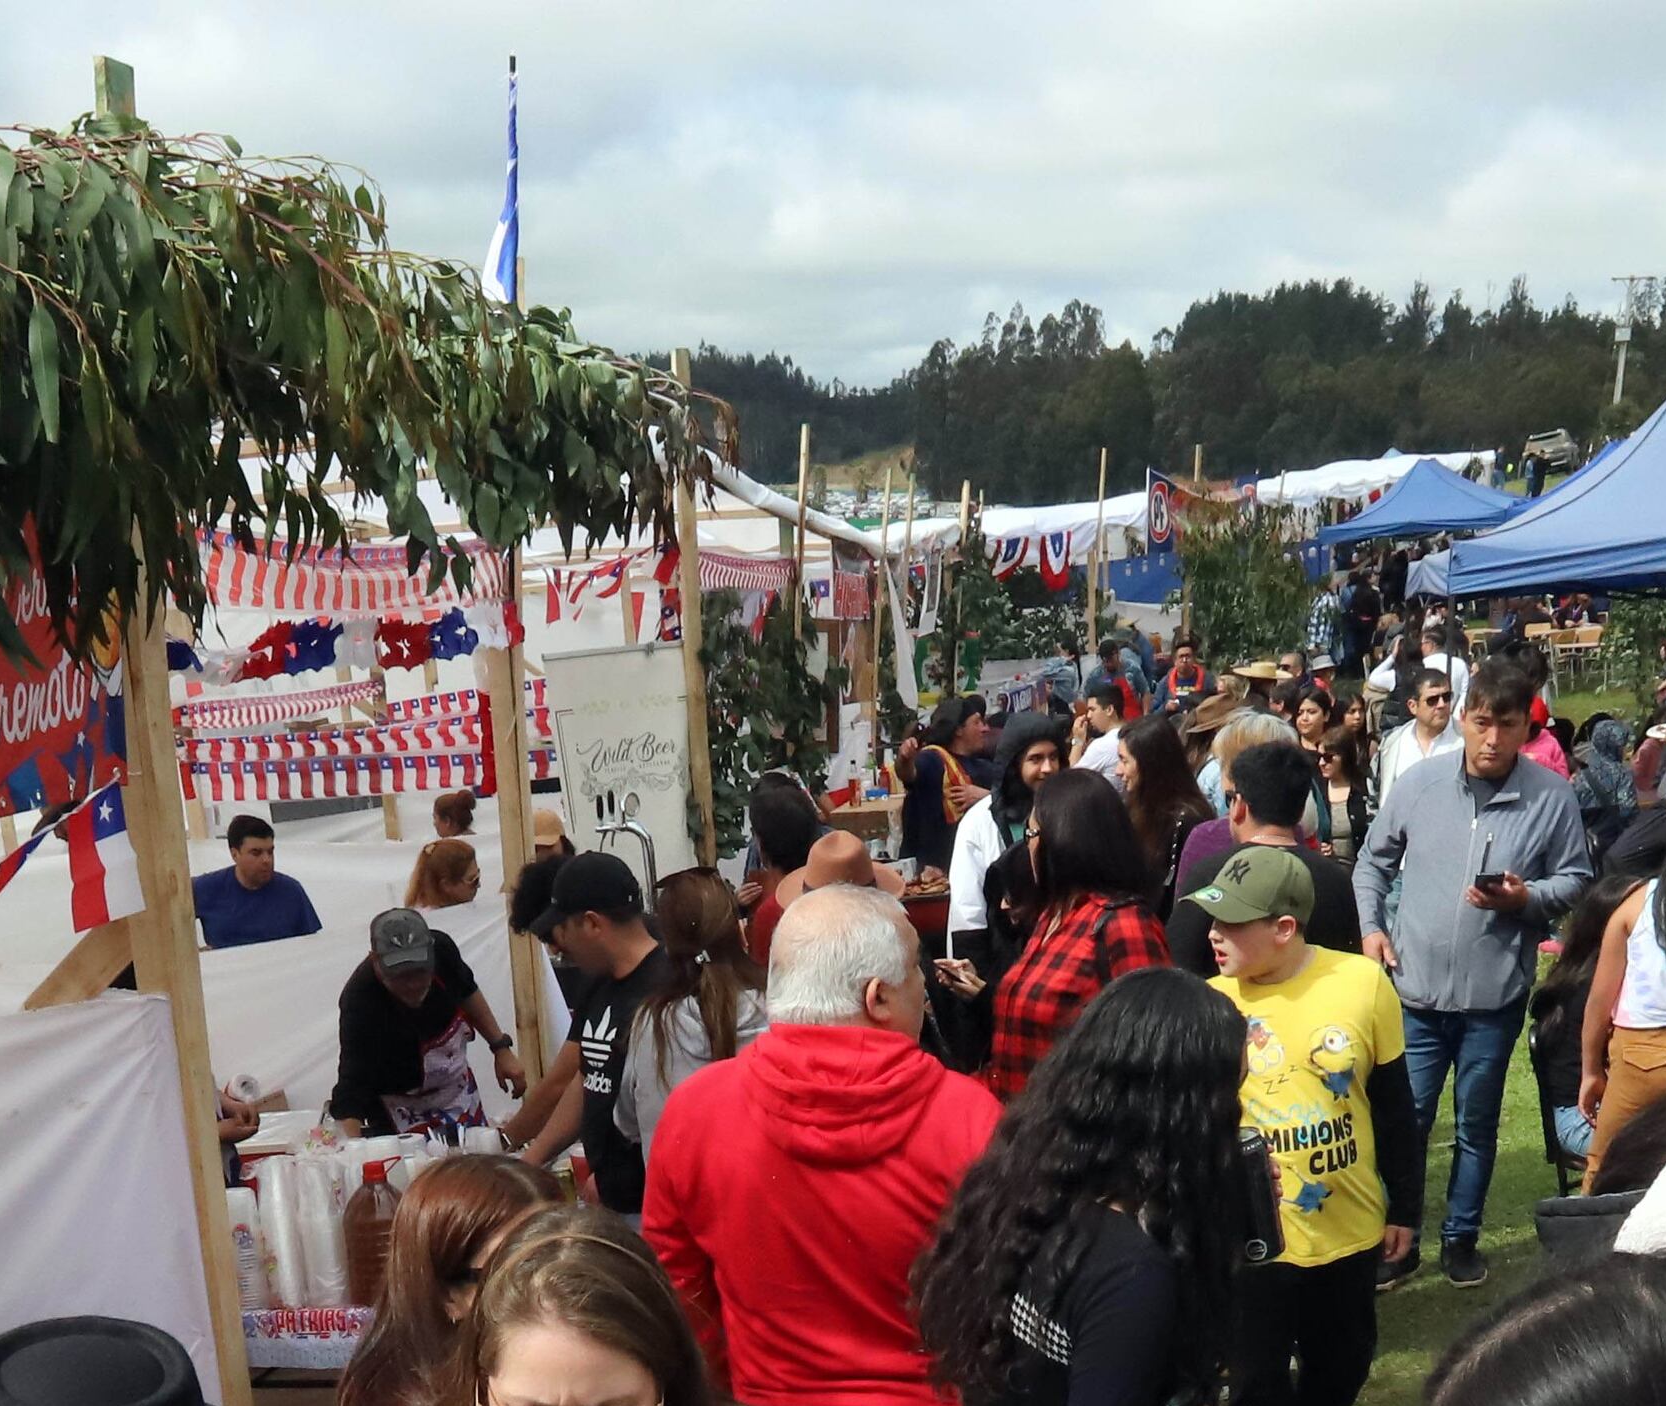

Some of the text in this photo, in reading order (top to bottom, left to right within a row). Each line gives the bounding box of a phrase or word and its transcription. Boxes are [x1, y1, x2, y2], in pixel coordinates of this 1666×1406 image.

[576, 731, 677, 773] Wild Beer
[1263, 1112, 1353, 1153] MINIONS
[1309, 1139, 1357, 1176] CLUB
